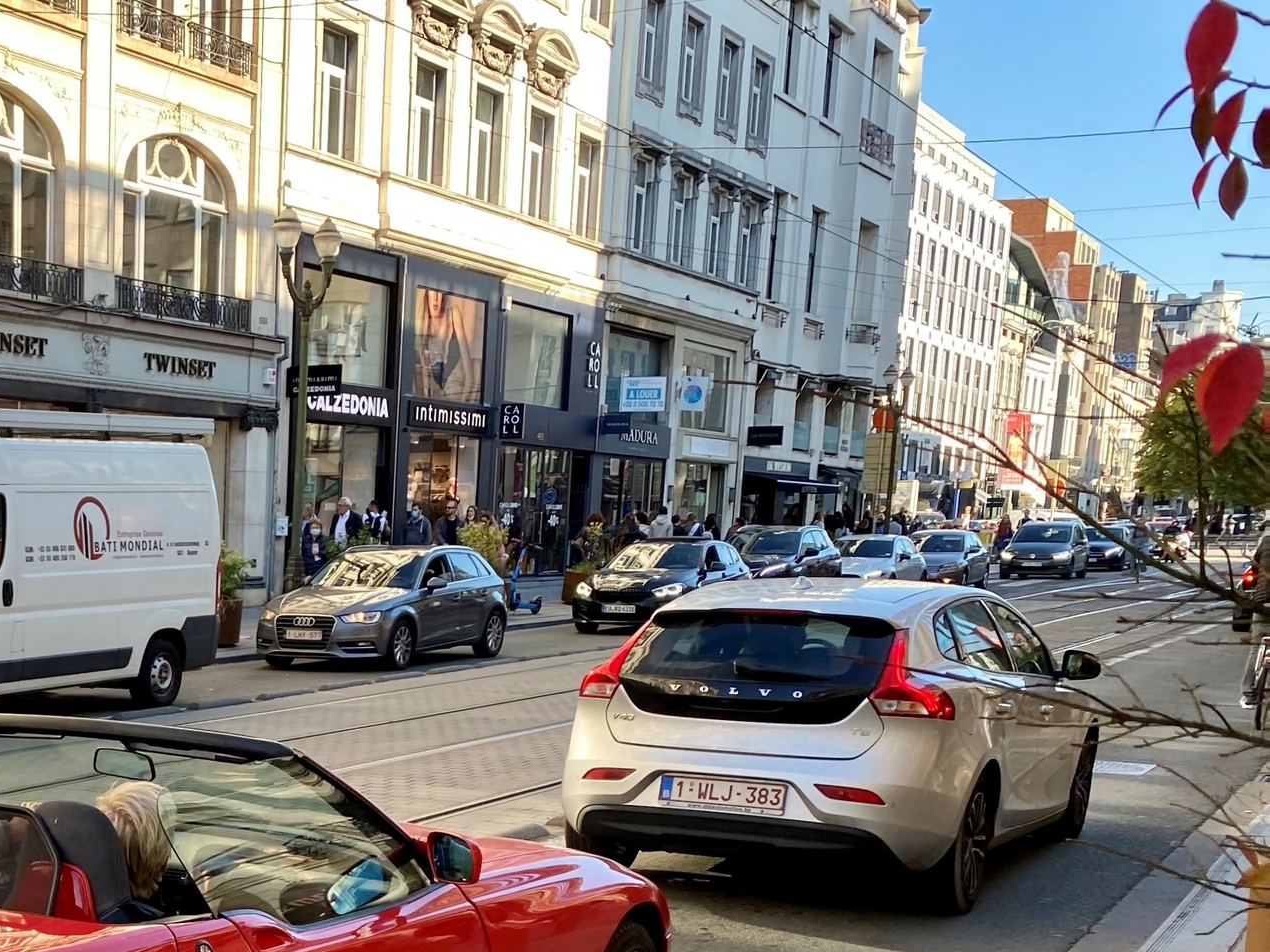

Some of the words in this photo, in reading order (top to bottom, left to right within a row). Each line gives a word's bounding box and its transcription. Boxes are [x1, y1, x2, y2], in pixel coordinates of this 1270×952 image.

[144, 352, 217, 379] TWINSET
[636, 390, 659, 399] LOUER
[307, 392, 389, 418] CALZEDONIA
[415, 404, 486, 428] intimissimi
[94, 541, 117, 553] BATI
[120, 540, 164, 552] MONDIAL
[669, 683, 803, 699] VOLVO
[612, 712, 635, 721] V40
[662, 789, 670, 798] B
[676, 781, 783, 806] 1-WLJ-383
